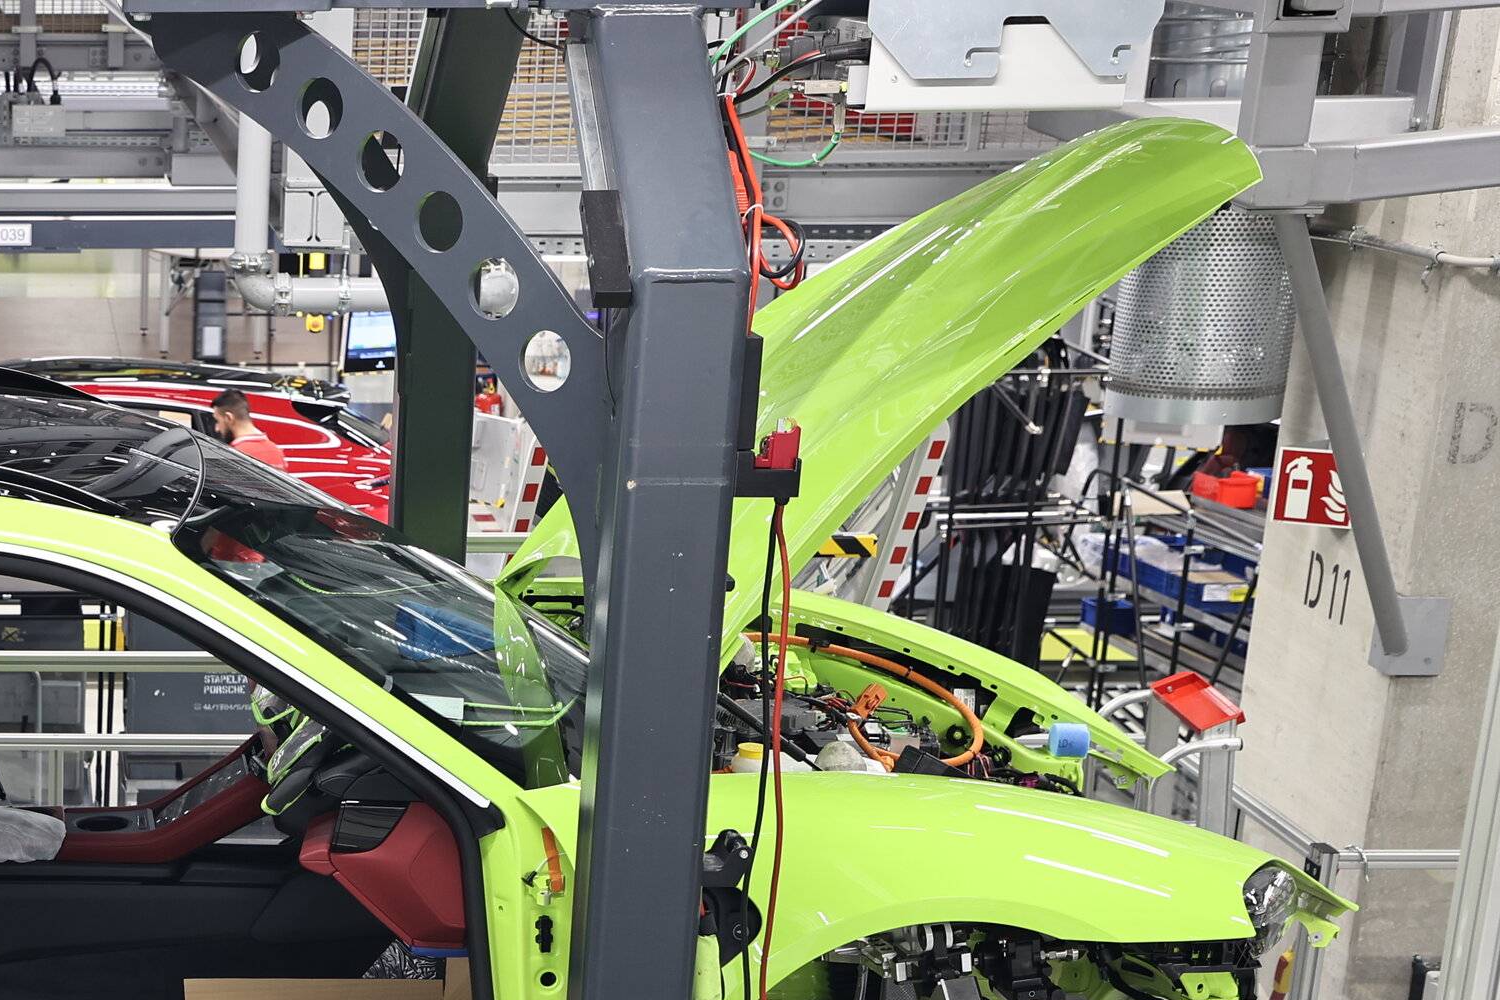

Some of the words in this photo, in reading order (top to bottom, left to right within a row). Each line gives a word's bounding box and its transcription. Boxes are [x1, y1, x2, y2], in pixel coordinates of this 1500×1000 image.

[0, 228, 26, 241] 039
[1303, 550, 1351, 625] D11
[203, 674, 248, 684] STAPELFA
[203, 684, 246, 694] PORSCHE
